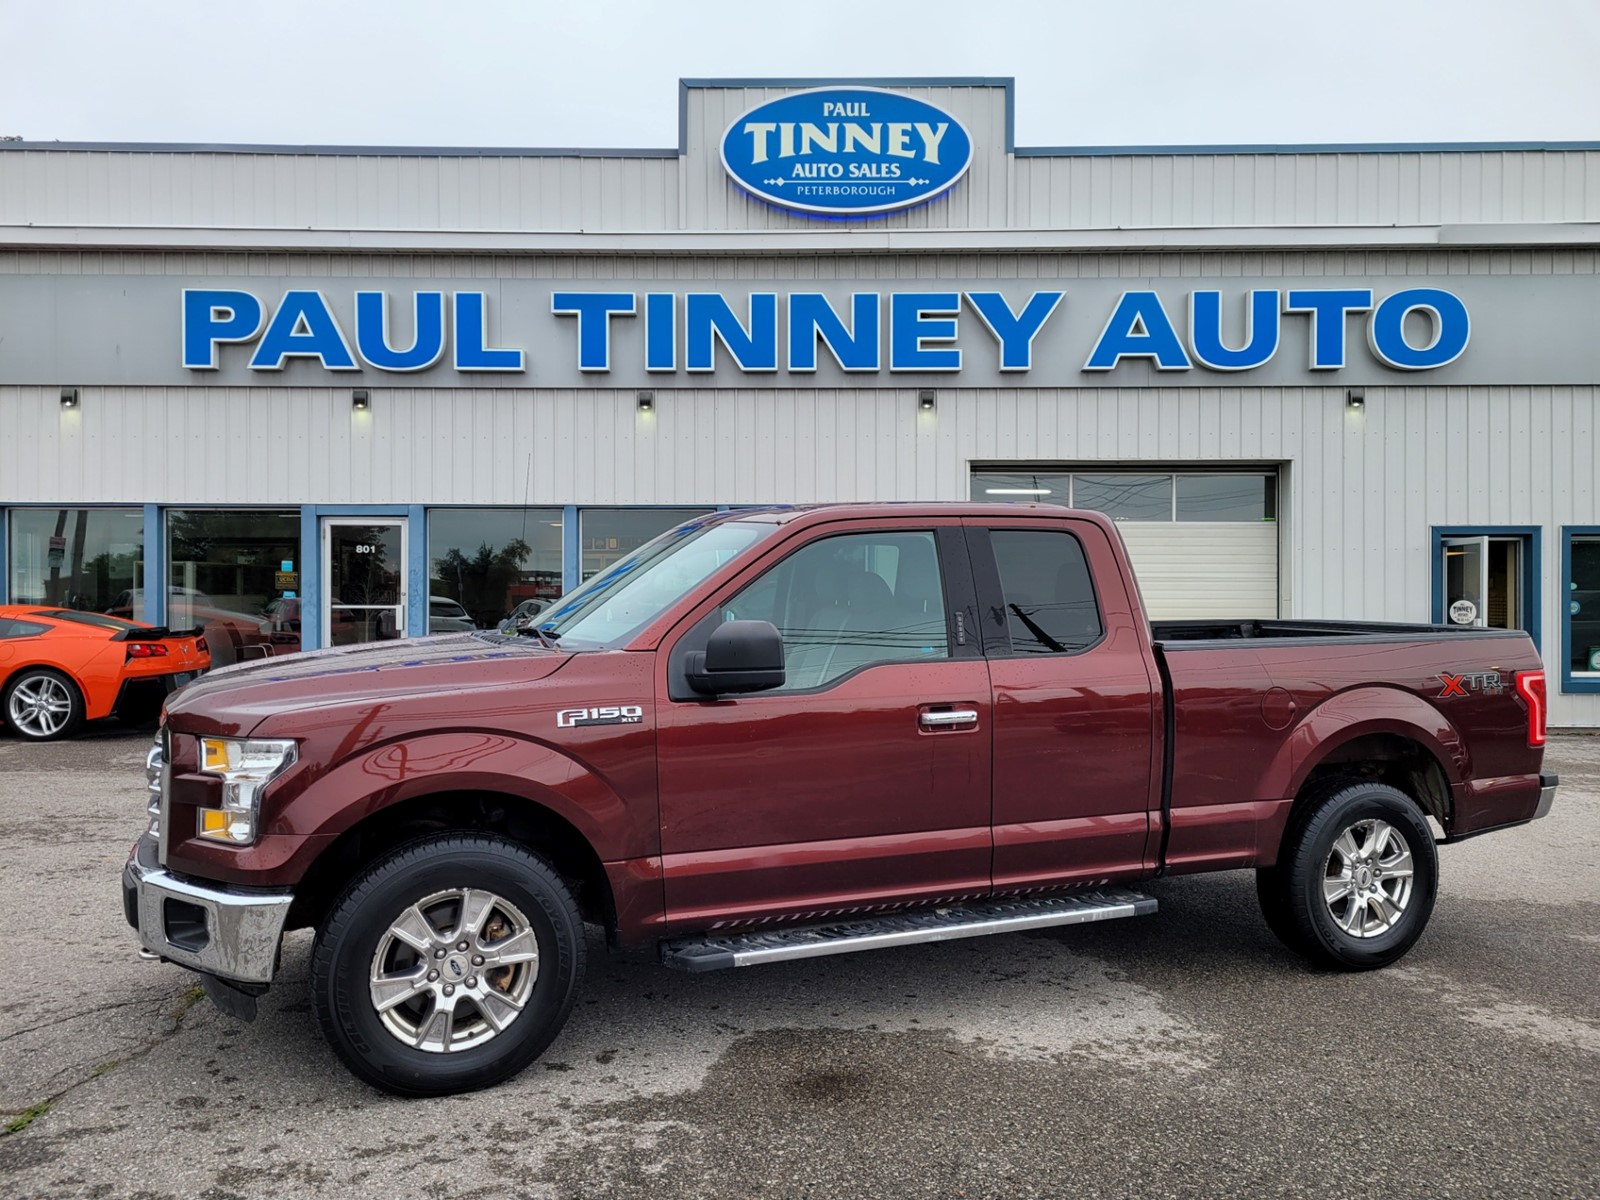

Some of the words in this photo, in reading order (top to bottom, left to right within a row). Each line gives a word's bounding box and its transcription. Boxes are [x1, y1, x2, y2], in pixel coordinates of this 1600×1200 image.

[823, 102, 870, 117] PAUL
[744, 122, 949, 165] TINNEY
[792, 163, 843, 178] AUTO
[849, 163, 901, 178] SALES
[796, 185, 896, 196] PETERBOROUGH
[181, 288, 526, 372] PAUL
[551, 290, 1067, 373] TINNEY
[1081, 287, 1472, 372] AUTO
[355, 544, 376, 554] 801
[1435, 672, 1503, 698] XTR
